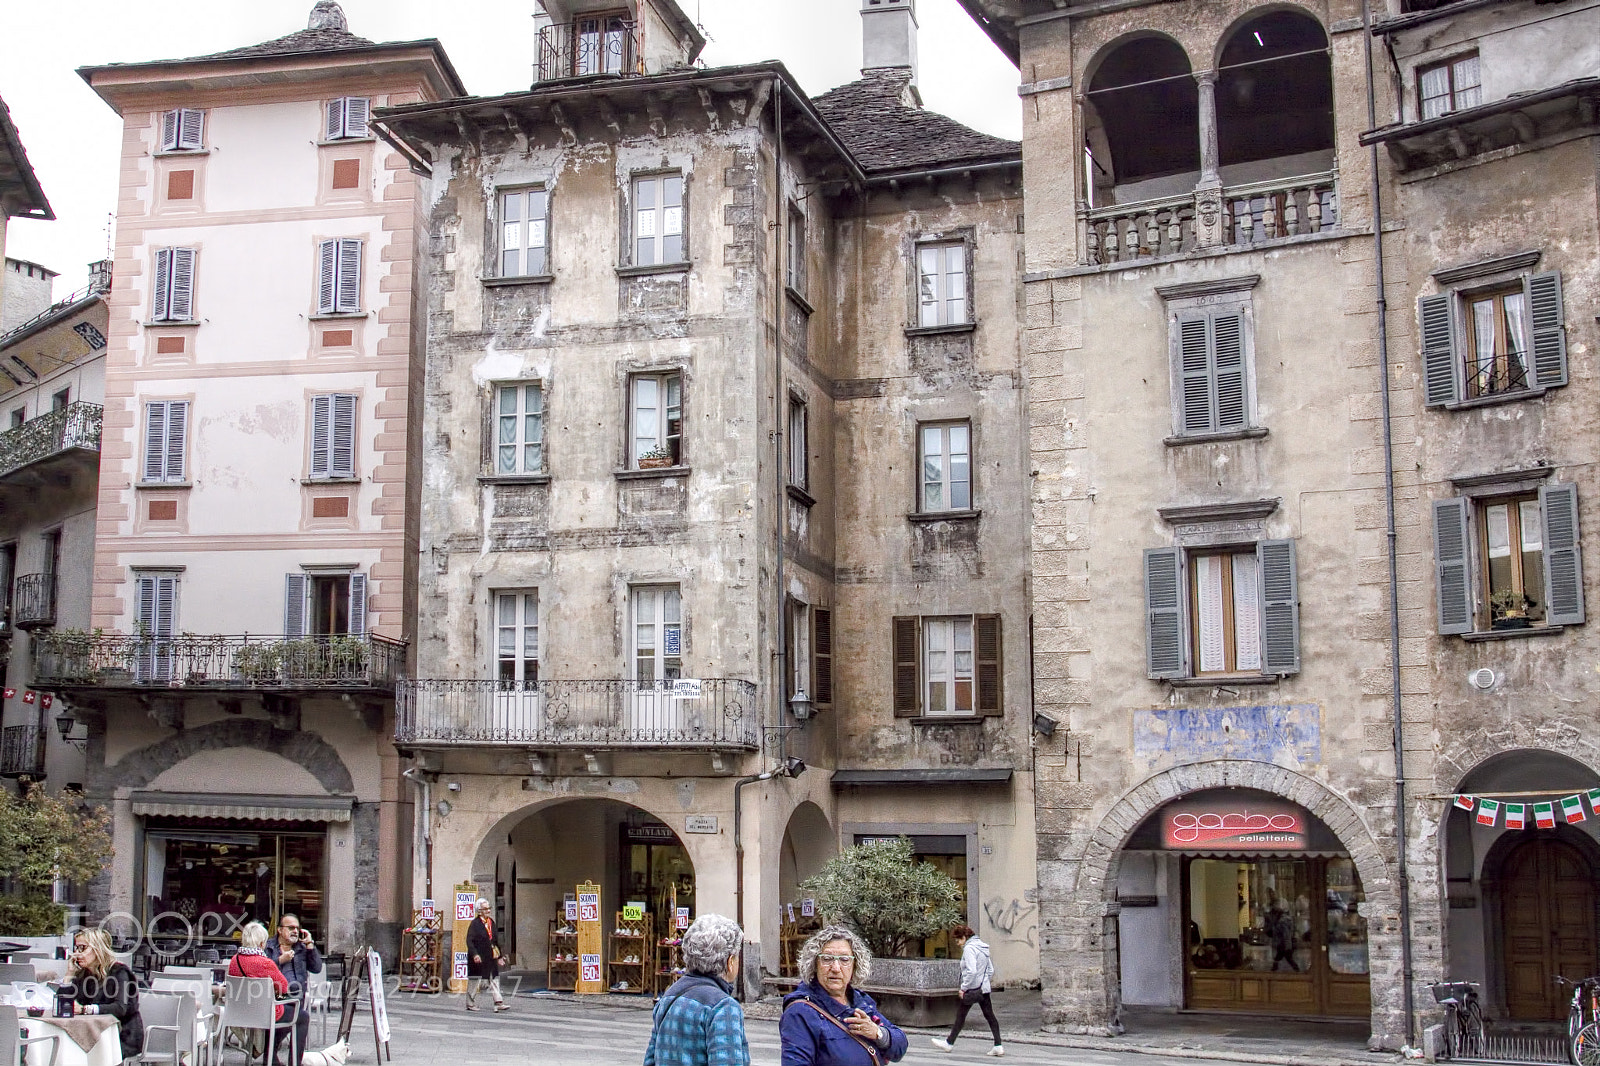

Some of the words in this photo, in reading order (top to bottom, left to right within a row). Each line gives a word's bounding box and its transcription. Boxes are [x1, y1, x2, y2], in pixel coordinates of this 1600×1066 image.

[1173, 810, 1295, 842] garbo
[1239, 834, 1295, 843] pelletteria
[457, 893, 475, 902] SCONTI
[580, 894, 598, 903] SCONTI
[582, 954, 599, 963] SCONTI
